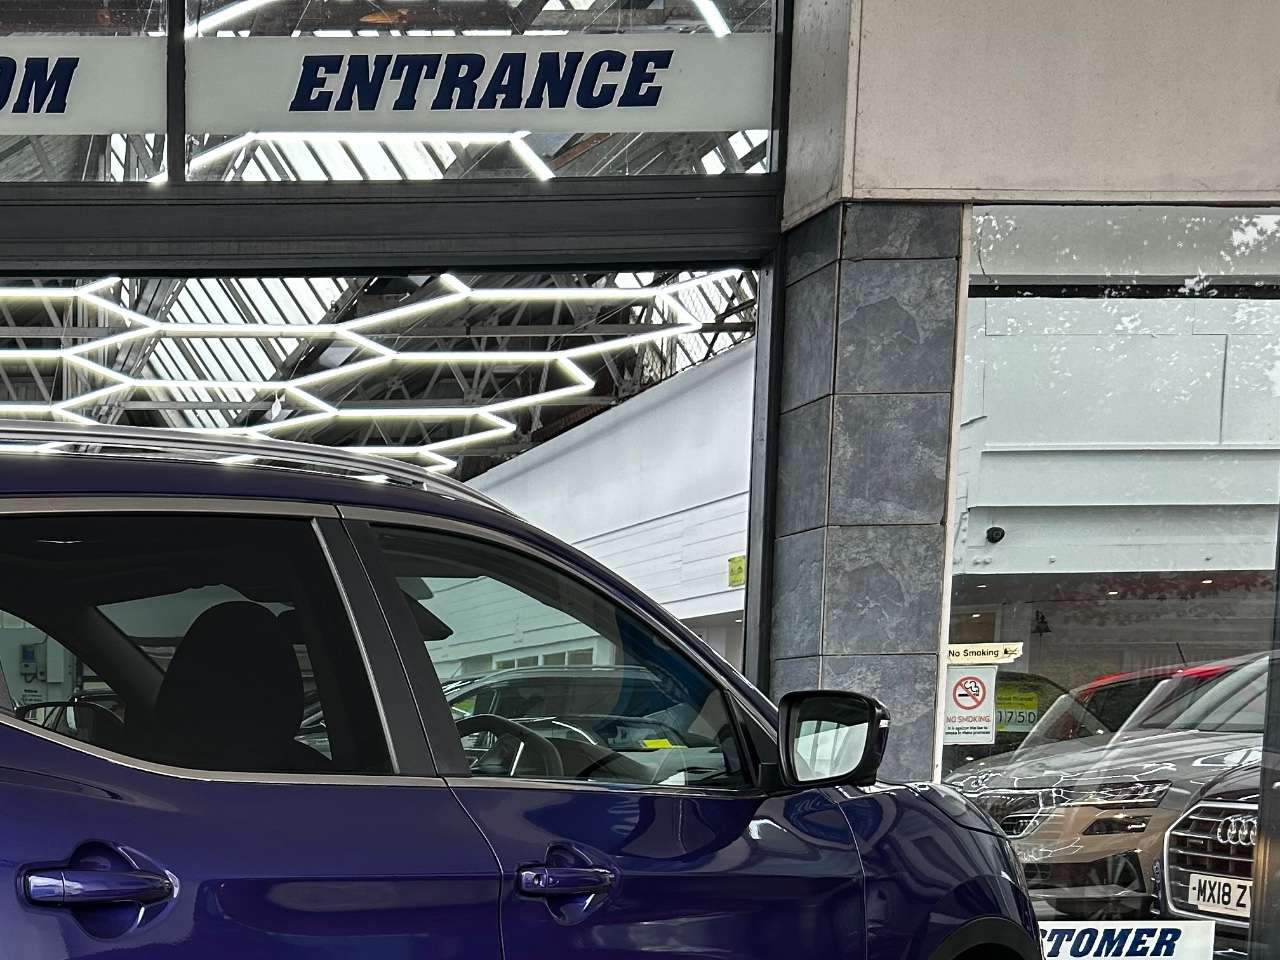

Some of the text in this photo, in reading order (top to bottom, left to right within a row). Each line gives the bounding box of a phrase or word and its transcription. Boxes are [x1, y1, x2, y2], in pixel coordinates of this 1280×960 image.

[288, 49, 674, 112] ENTRANCE
[963, 649, 999, 657] Smoking
[958, 715, 991, 723] SMOKING
[1197, 878, 1231, 905] MX18
